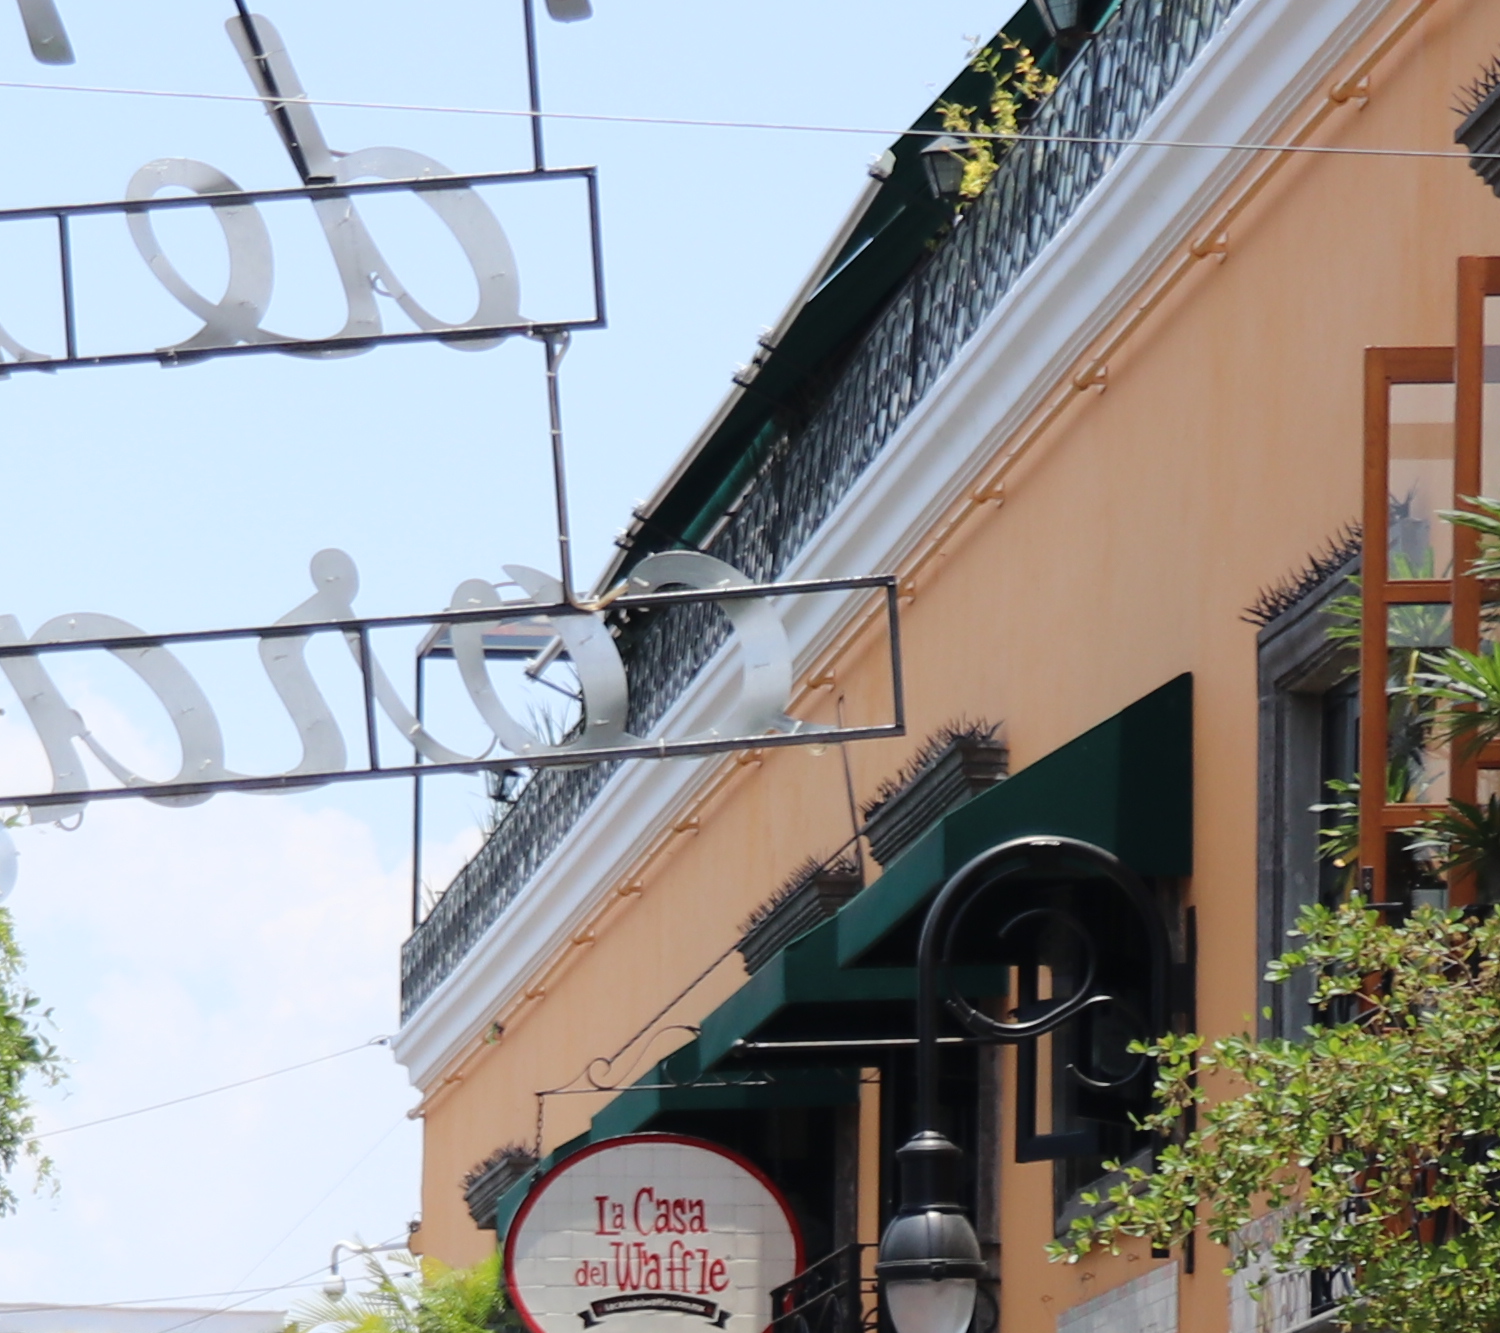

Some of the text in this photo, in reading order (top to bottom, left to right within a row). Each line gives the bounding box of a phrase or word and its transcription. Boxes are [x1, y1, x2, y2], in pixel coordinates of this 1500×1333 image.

[594, 1187, 707, 1235] La Casa
[575, 1240, 729, 1294] del Waffle
